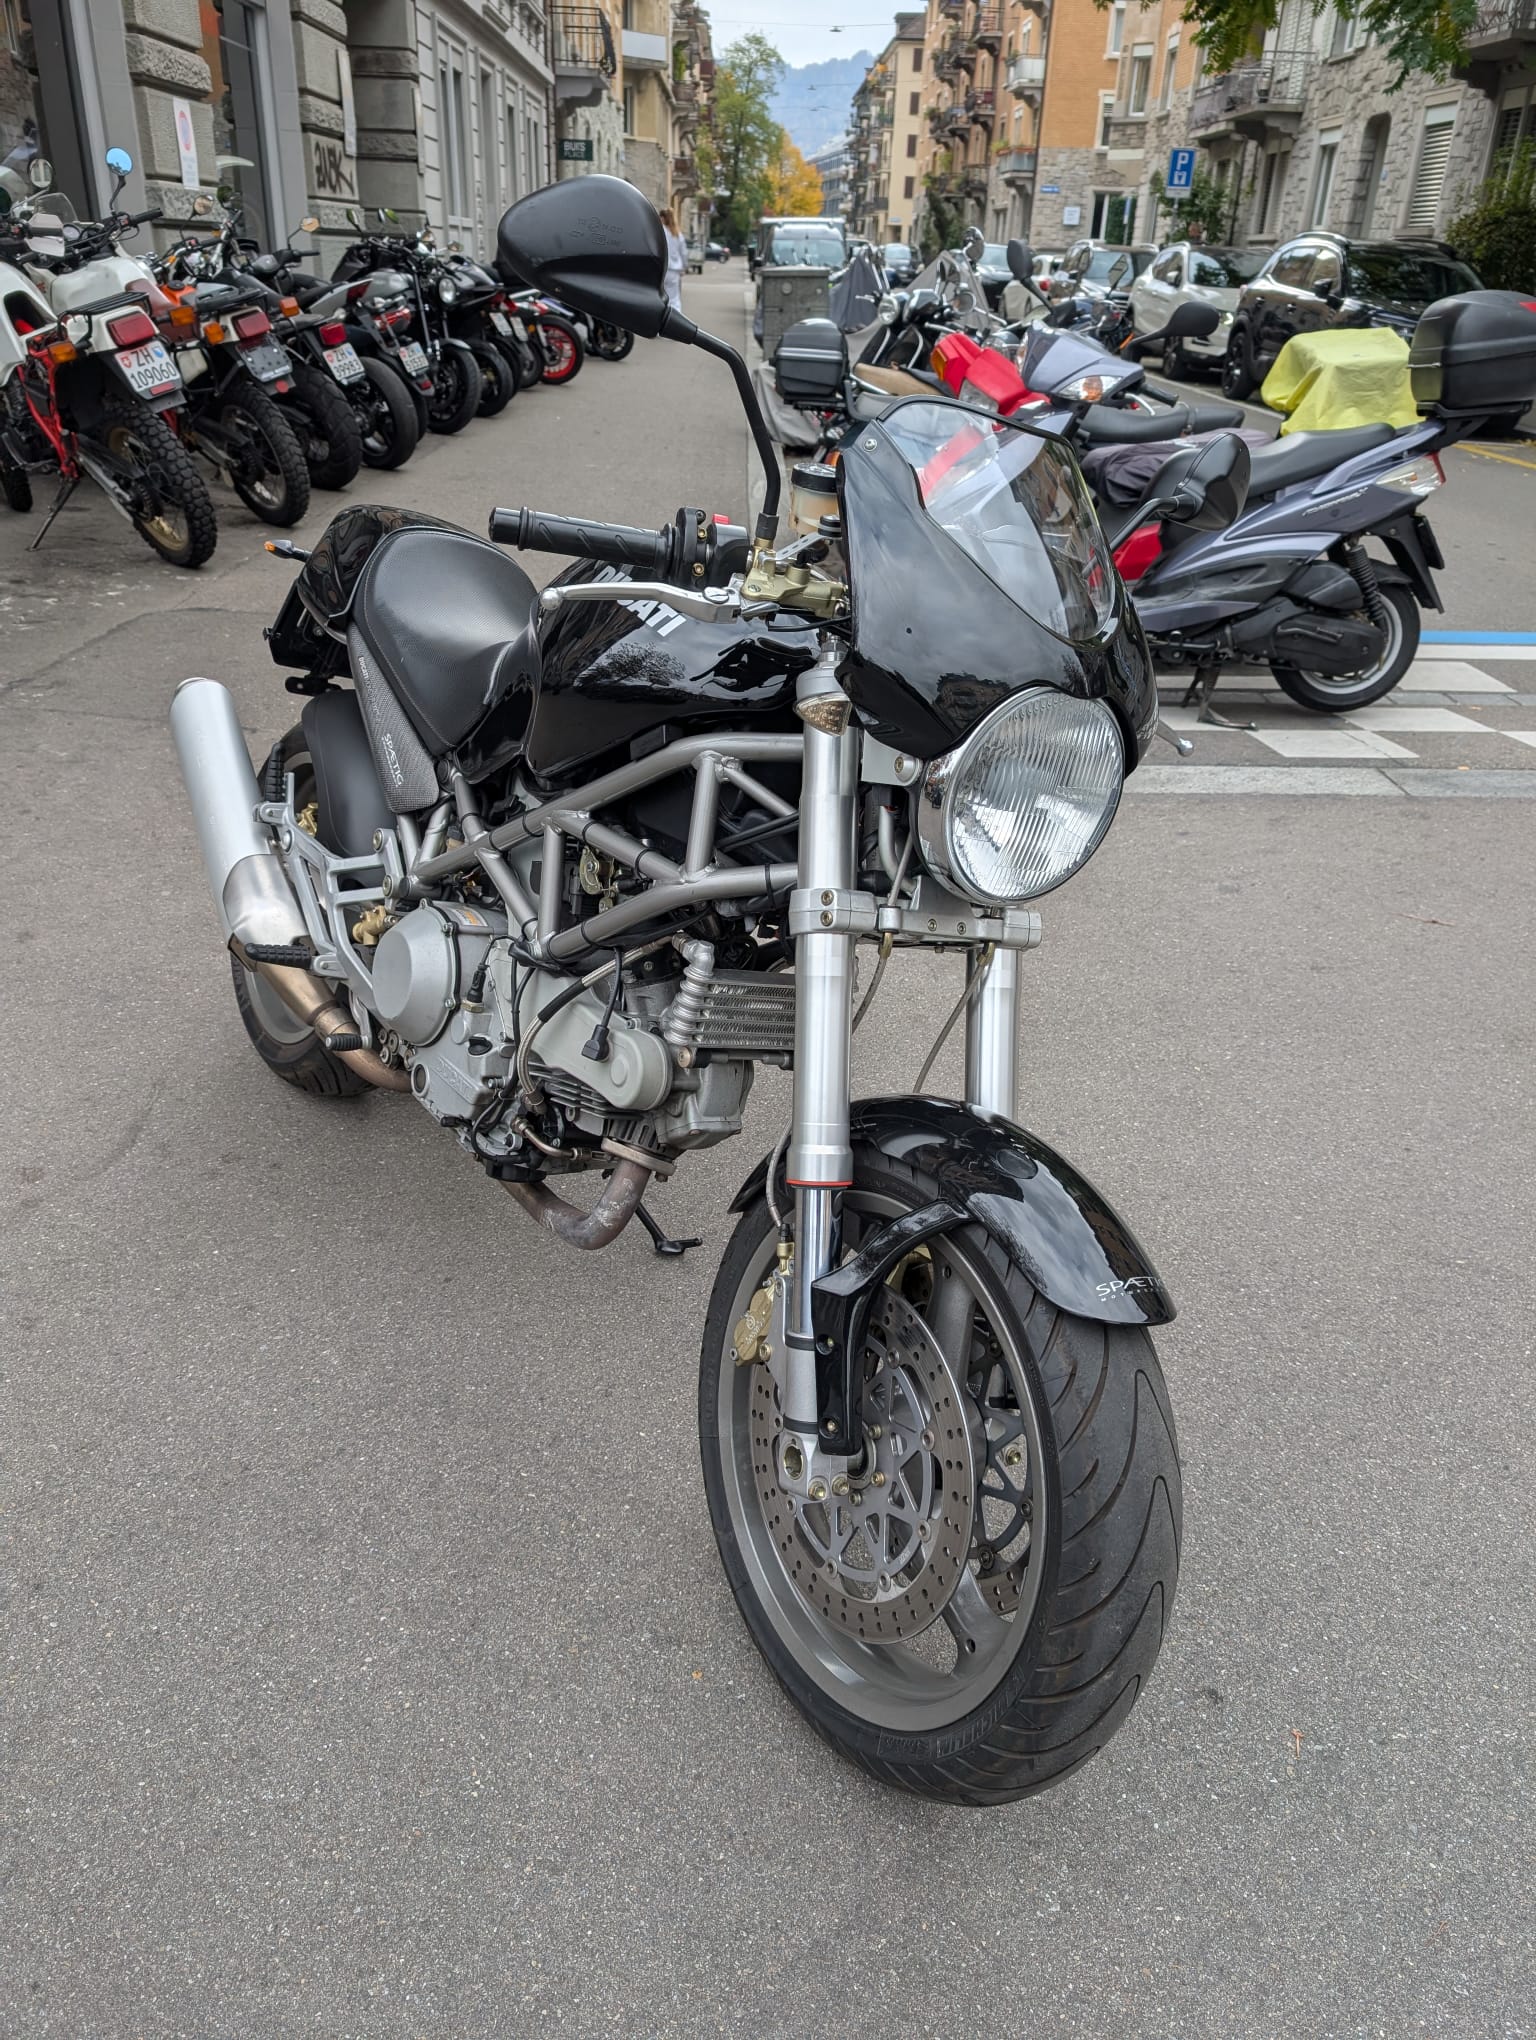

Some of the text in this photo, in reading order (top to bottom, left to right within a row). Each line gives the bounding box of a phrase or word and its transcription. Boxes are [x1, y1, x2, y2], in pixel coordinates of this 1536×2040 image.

[1176, 152, 1189, 170] P
[131, 347, 155, 367] ZH
[131, 362, 177, 388] 109060
[592, 565, 687, 637] DATI
